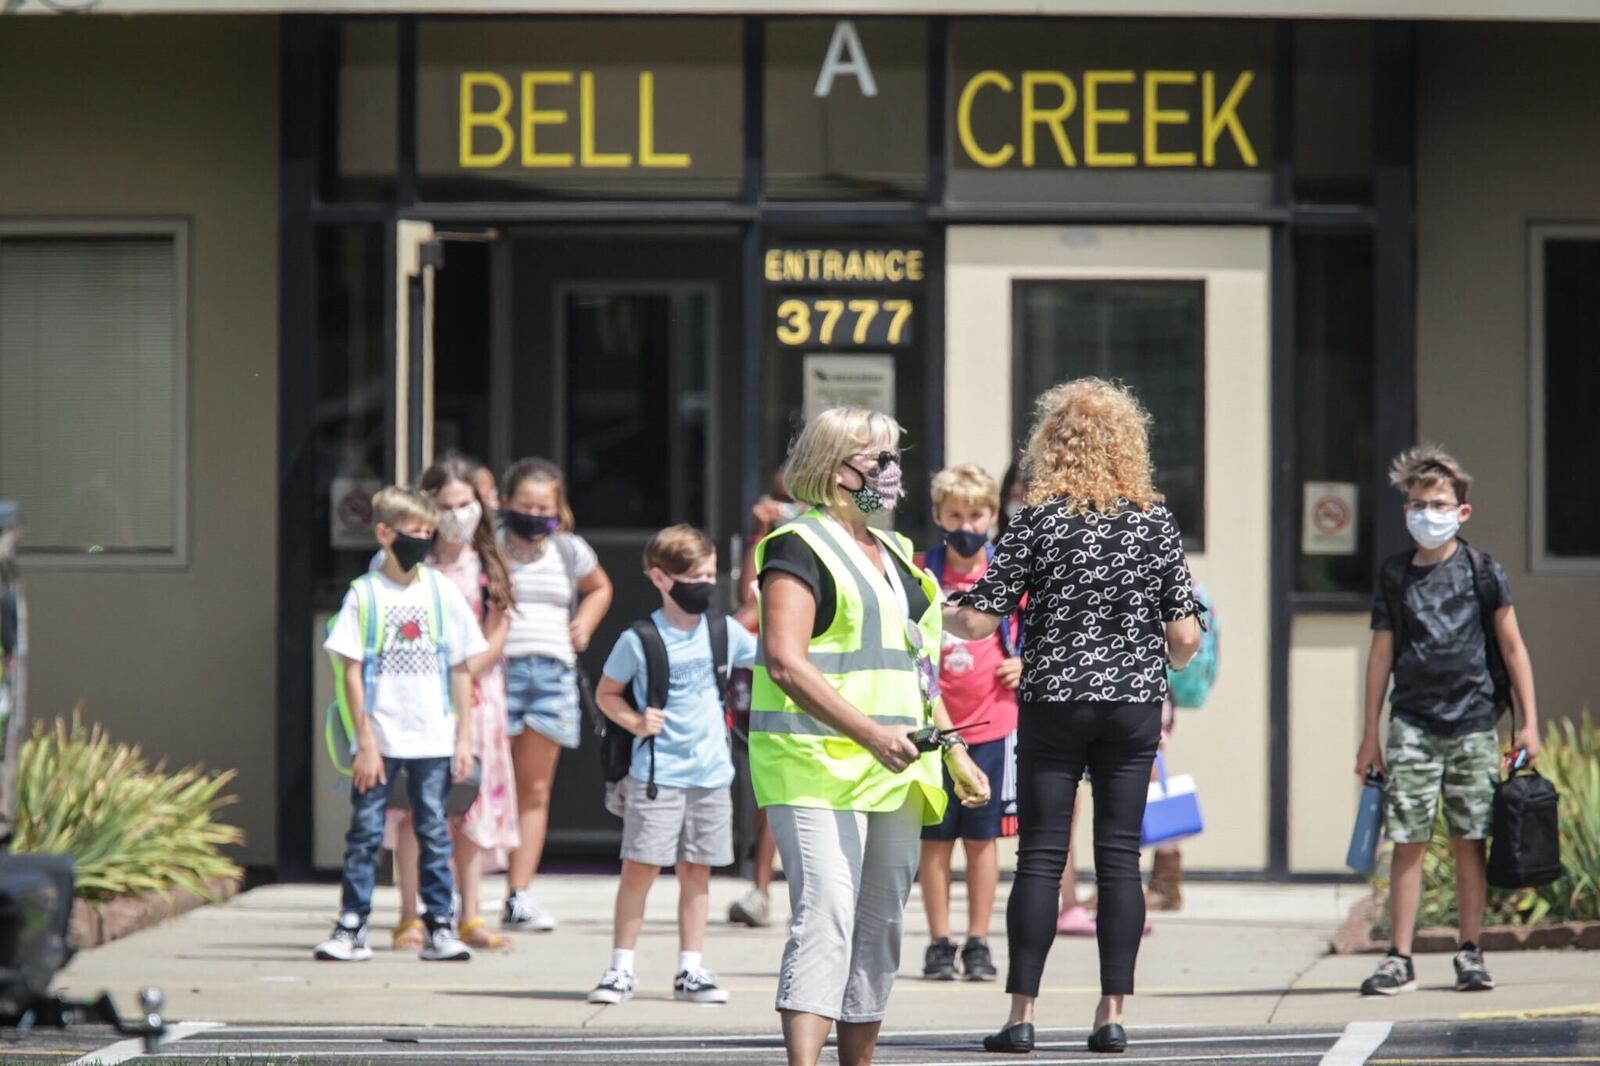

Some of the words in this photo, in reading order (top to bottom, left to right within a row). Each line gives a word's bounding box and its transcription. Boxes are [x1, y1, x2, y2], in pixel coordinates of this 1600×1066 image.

[814, 22, 877, 98] A
[459, 70, 691, 168] BELL
[956, 70, 1258, 168] CREEK
[765, 248, 925, 283] ENTRANCE
[776, 298, 913, 346] 3777
